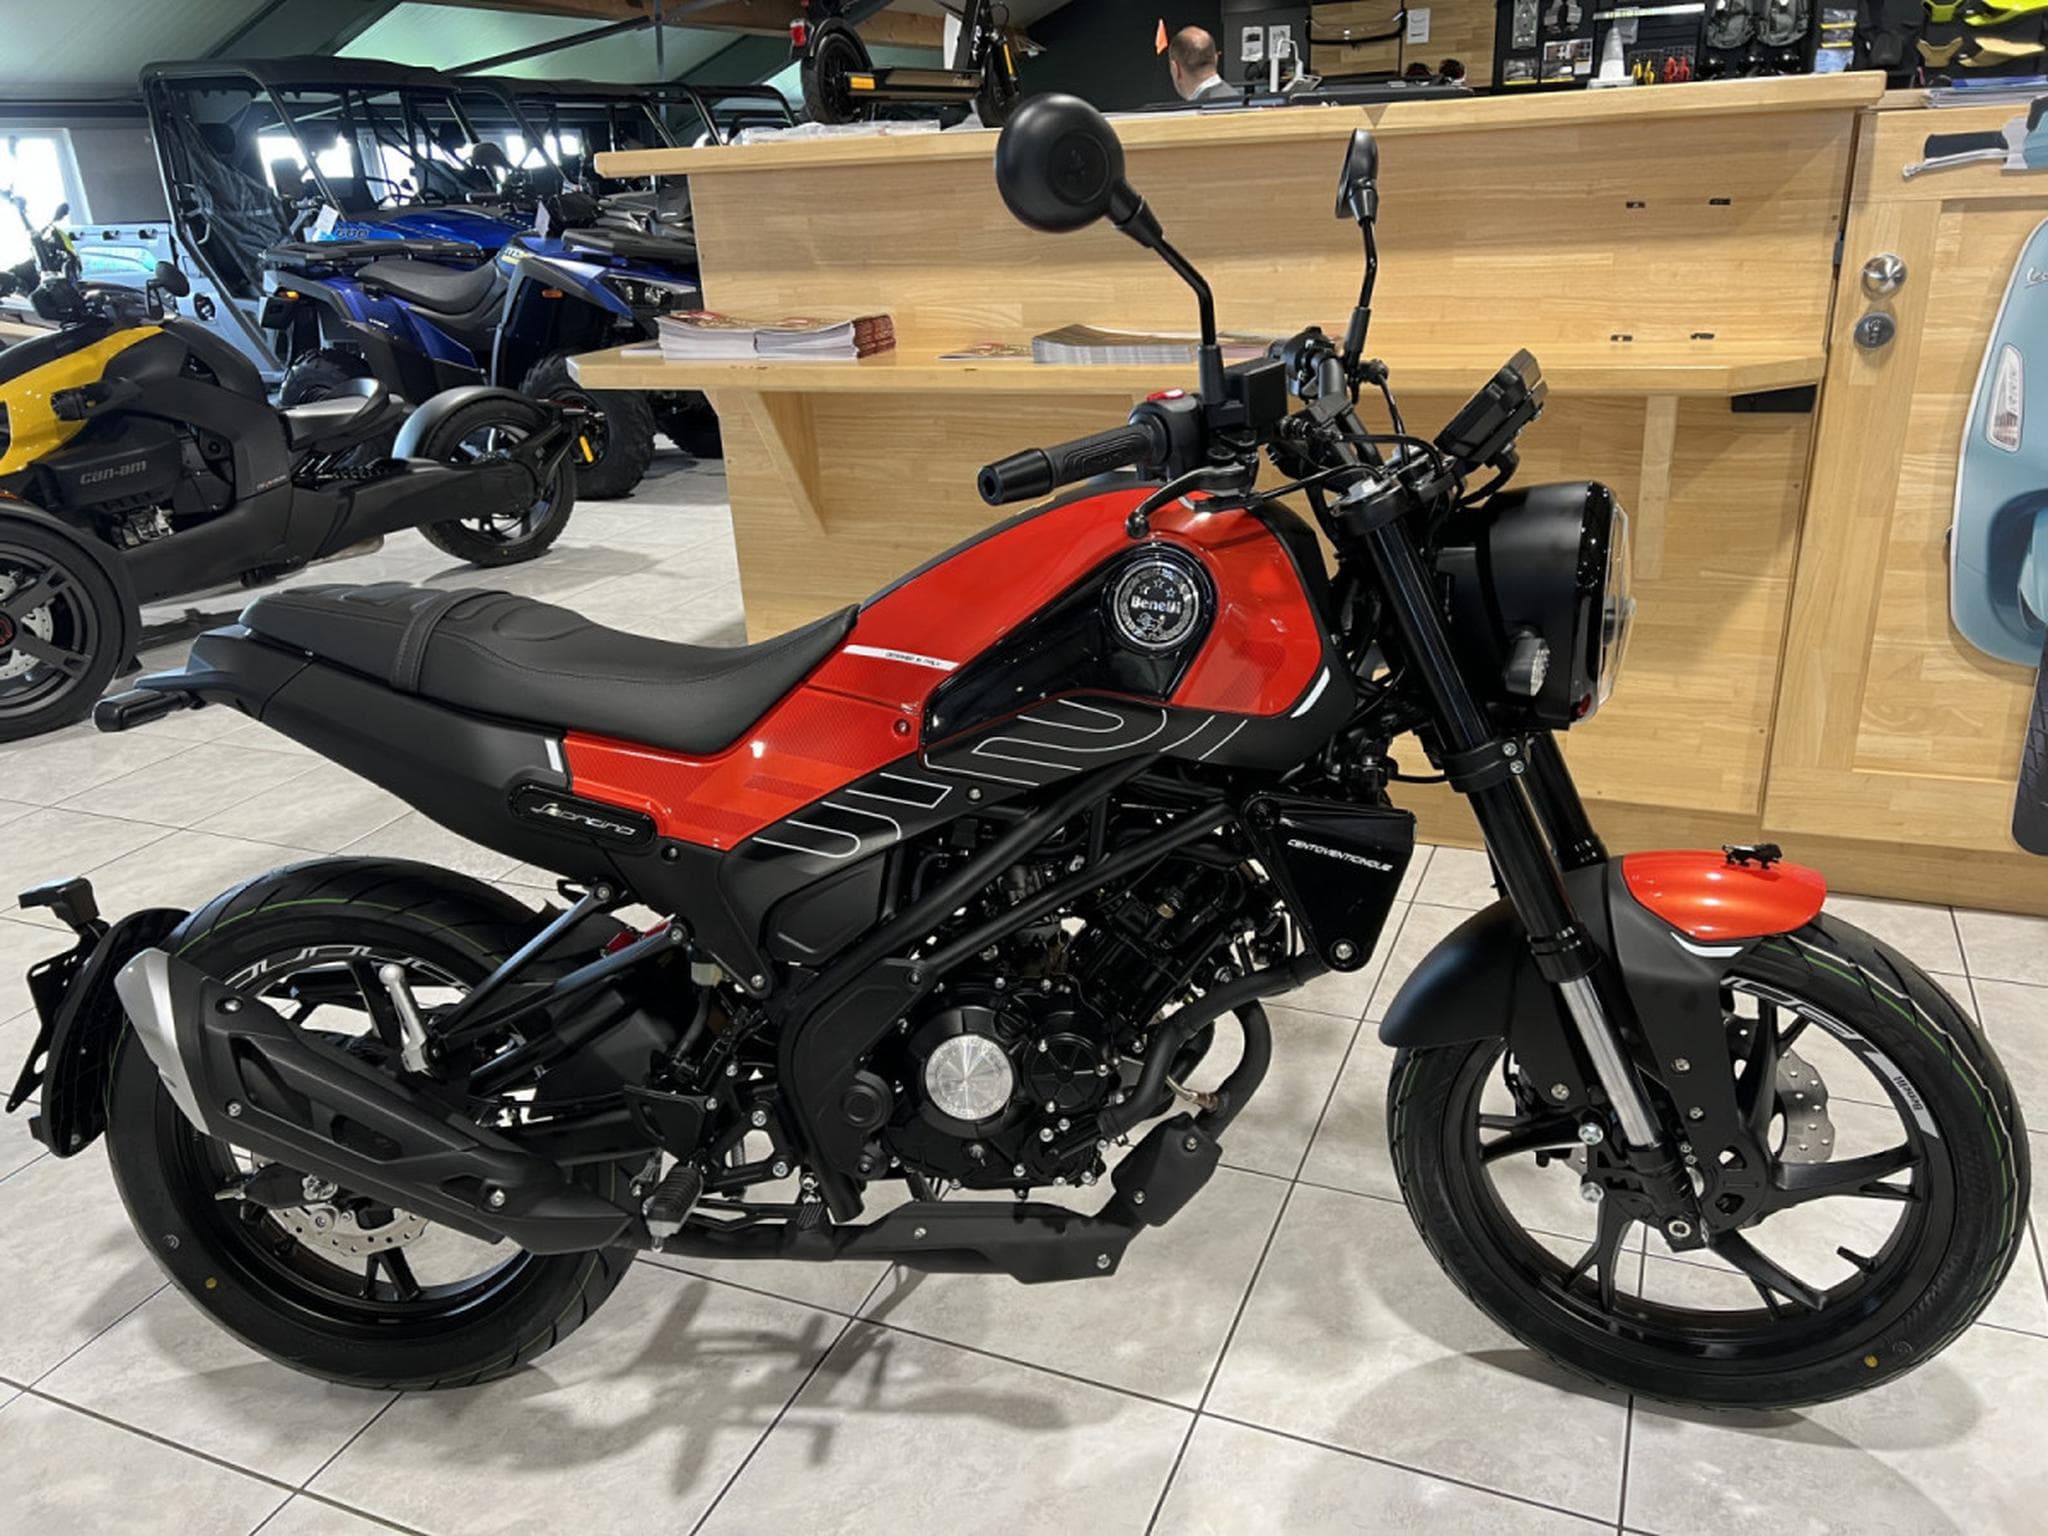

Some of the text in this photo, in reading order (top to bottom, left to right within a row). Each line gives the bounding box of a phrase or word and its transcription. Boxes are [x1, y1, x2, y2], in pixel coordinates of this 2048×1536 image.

[80, 460, 147, 485] can-am
[1130, 595, 1182, 614] Benelli
[530, 803, 636, 836] Leoncino
[1893, 1075, 1924, 1111] Benelli
